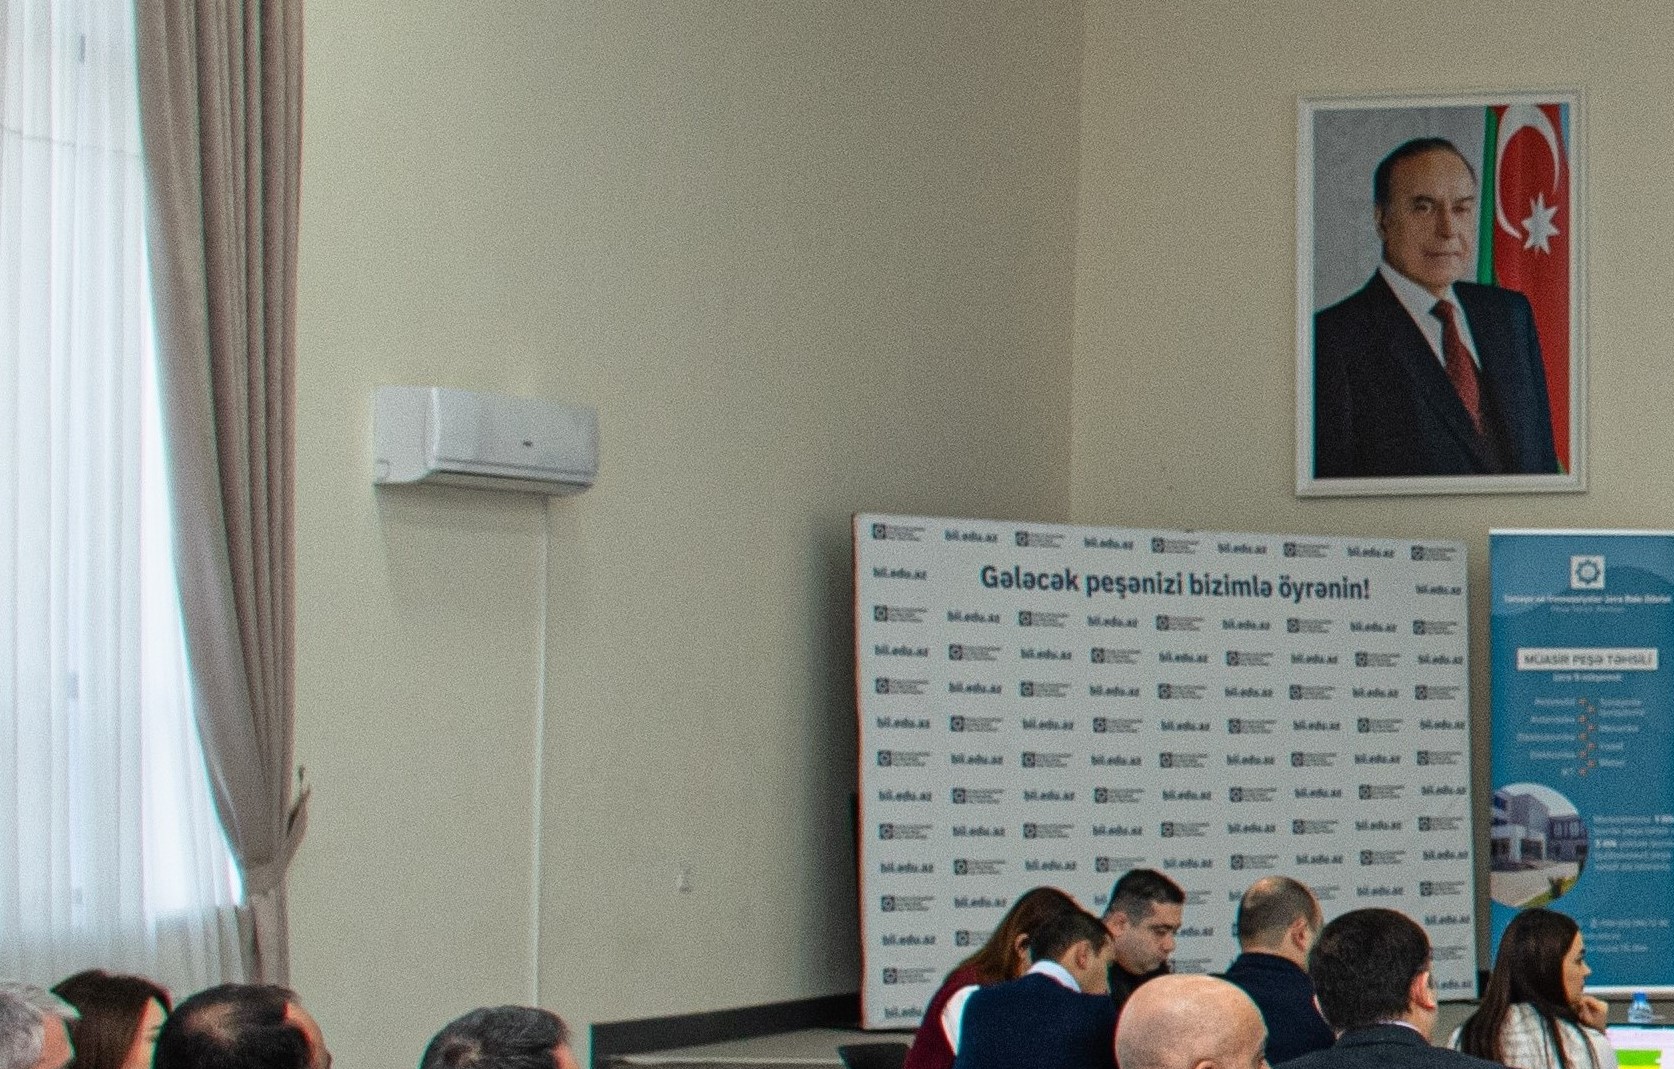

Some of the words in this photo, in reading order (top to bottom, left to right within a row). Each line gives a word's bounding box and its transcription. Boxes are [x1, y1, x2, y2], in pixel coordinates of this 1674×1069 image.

[981, 564, 1080, 590] Gələcək
[1086, 570, 1182, 599] peşənizi
[1189, 573, 1272, 598] bizimlə
[1279, 575, 1370, 603] öyrənin!
